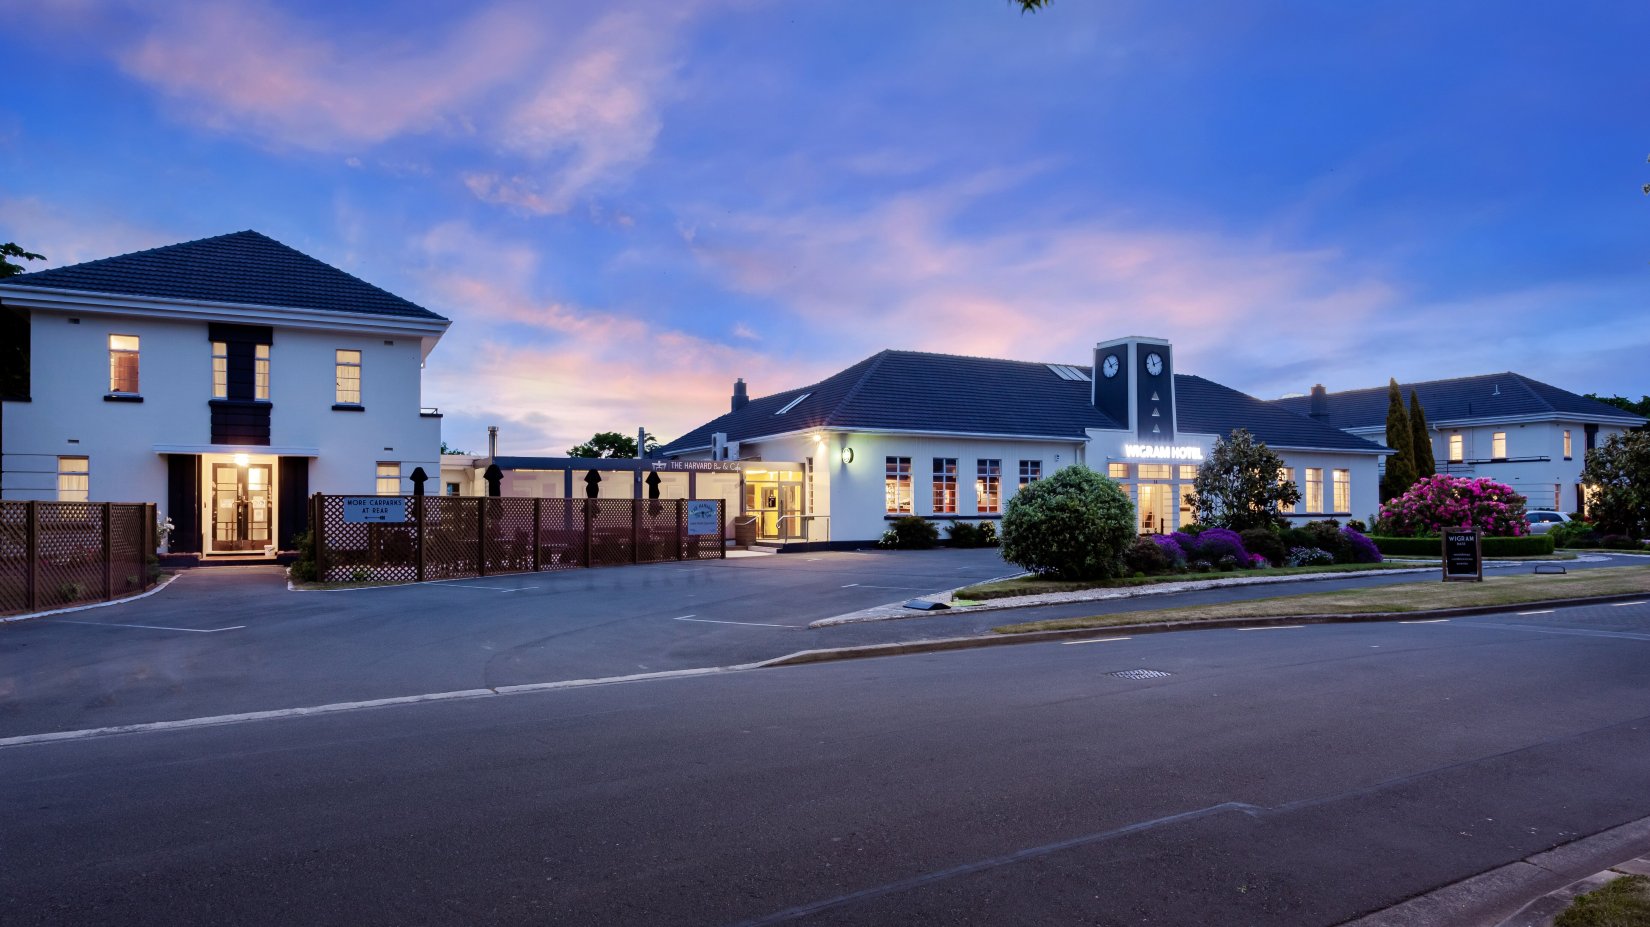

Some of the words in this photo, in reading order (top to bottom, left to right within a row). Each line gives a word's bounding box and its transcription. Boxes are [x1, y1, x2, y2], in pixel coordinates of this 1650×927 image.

[1125, 444, 1171, 458] WIGRAM
[1171, 446, 1204, 460] HOTEL
[671, 461, 683, 470] THE
[684, 461, 712, 470] HARVARD
